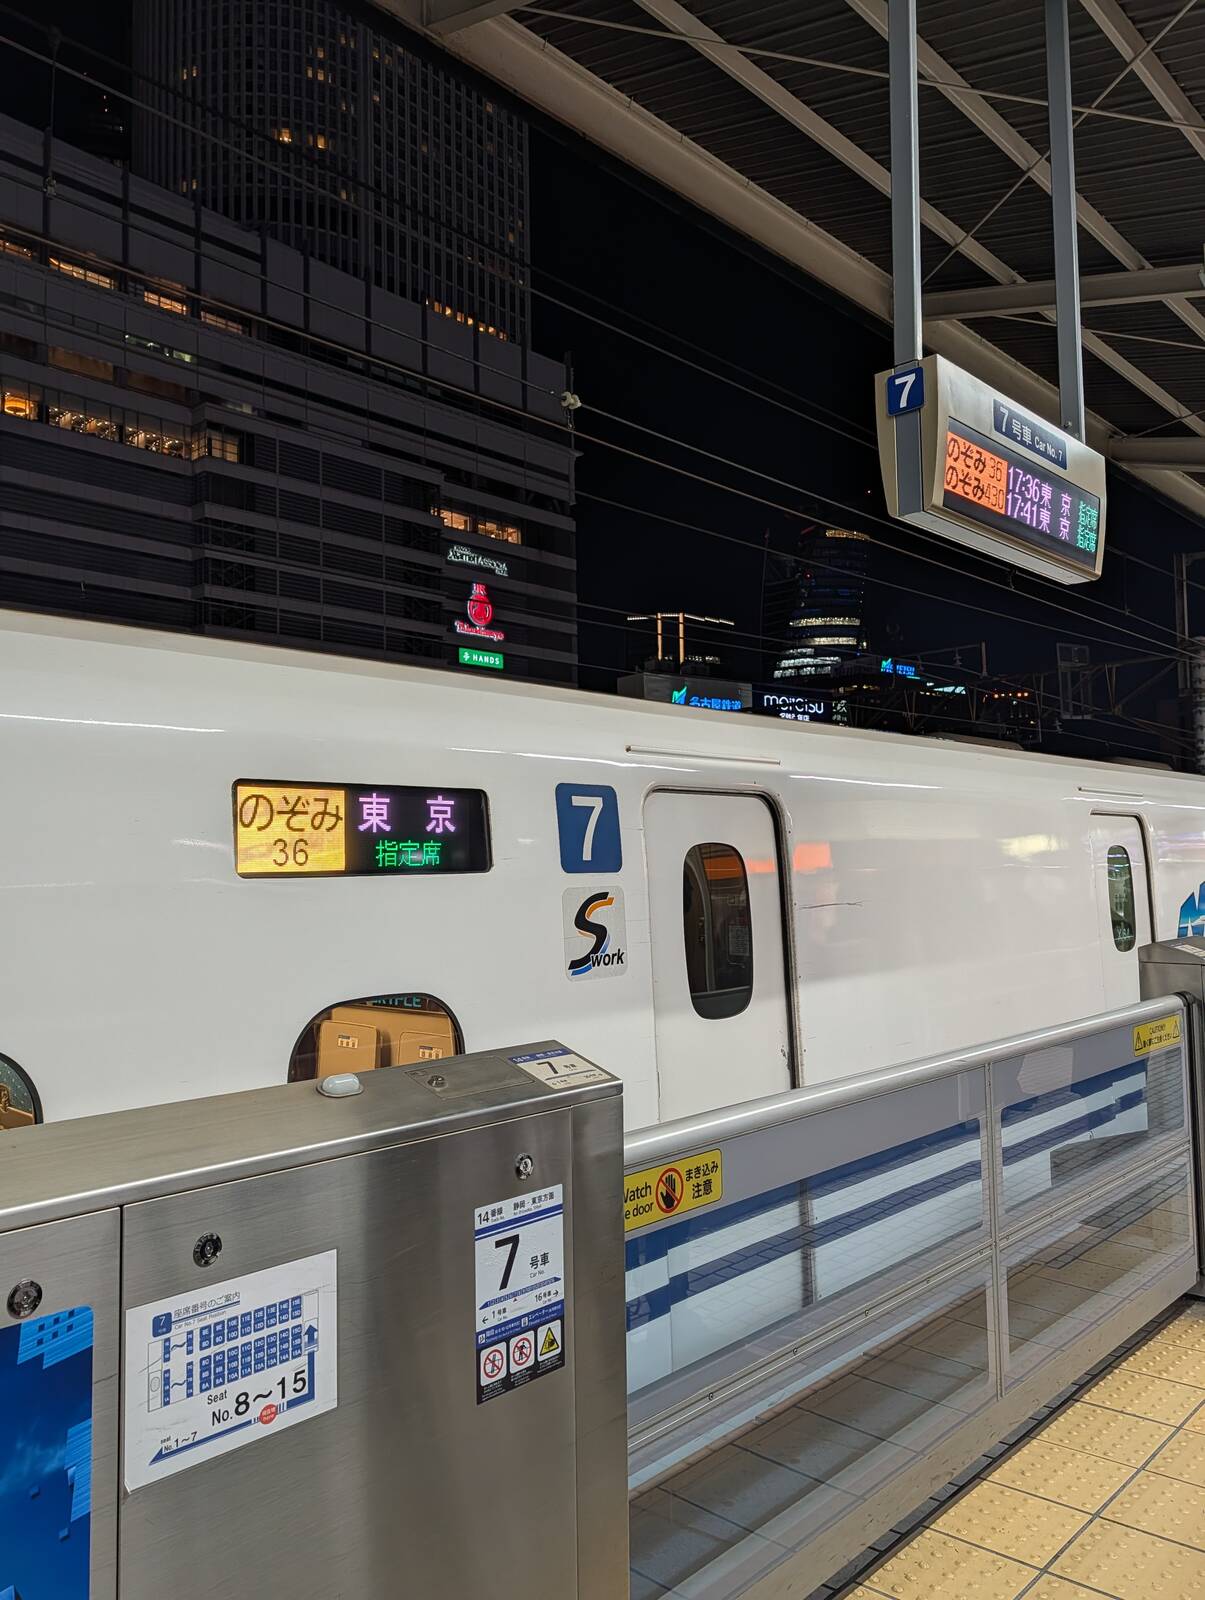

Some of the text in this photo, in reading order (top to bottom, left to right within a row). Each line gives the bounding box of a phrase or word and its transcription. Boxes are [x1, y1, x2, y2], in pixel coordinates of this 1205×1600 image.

[895, 373, 916, 408] 7
[1000, 406, 1009, 432] 7
[1034, 436, 1046, 451] Car
[1058, 450, 1063, 461] 7
[947, 437, 986, 474] のぞみ
[989, 457, 1003, 481] 36
[1008, 466, 1041, 502] 17:36
[945, 464, 985, 501] のぞみ
[985, 483, 1005, 510] 430
[1006, 492, 1037, 527] 17:41
[472, 654, 500, 665] HANDS
[239, 794, 343, 832] のぞみ
[571, 795, 604, 861] 7
[272, 838, 442, 867] 36 指定席
[591, 949, 625, 968] work
[536, 1060, 559, 1075] 7
[685, 1160, 719, 1182] まき込み
[691, 1179, 713, 1200] 注意
[632, 1202, 654, 1218] door
[494, 1233, 520, 1291] 7
[529, 1252, 550, 1270] 号車
[159, 1315, 167, 1327] 7
[207, 1389, 228, 1405] Seat
